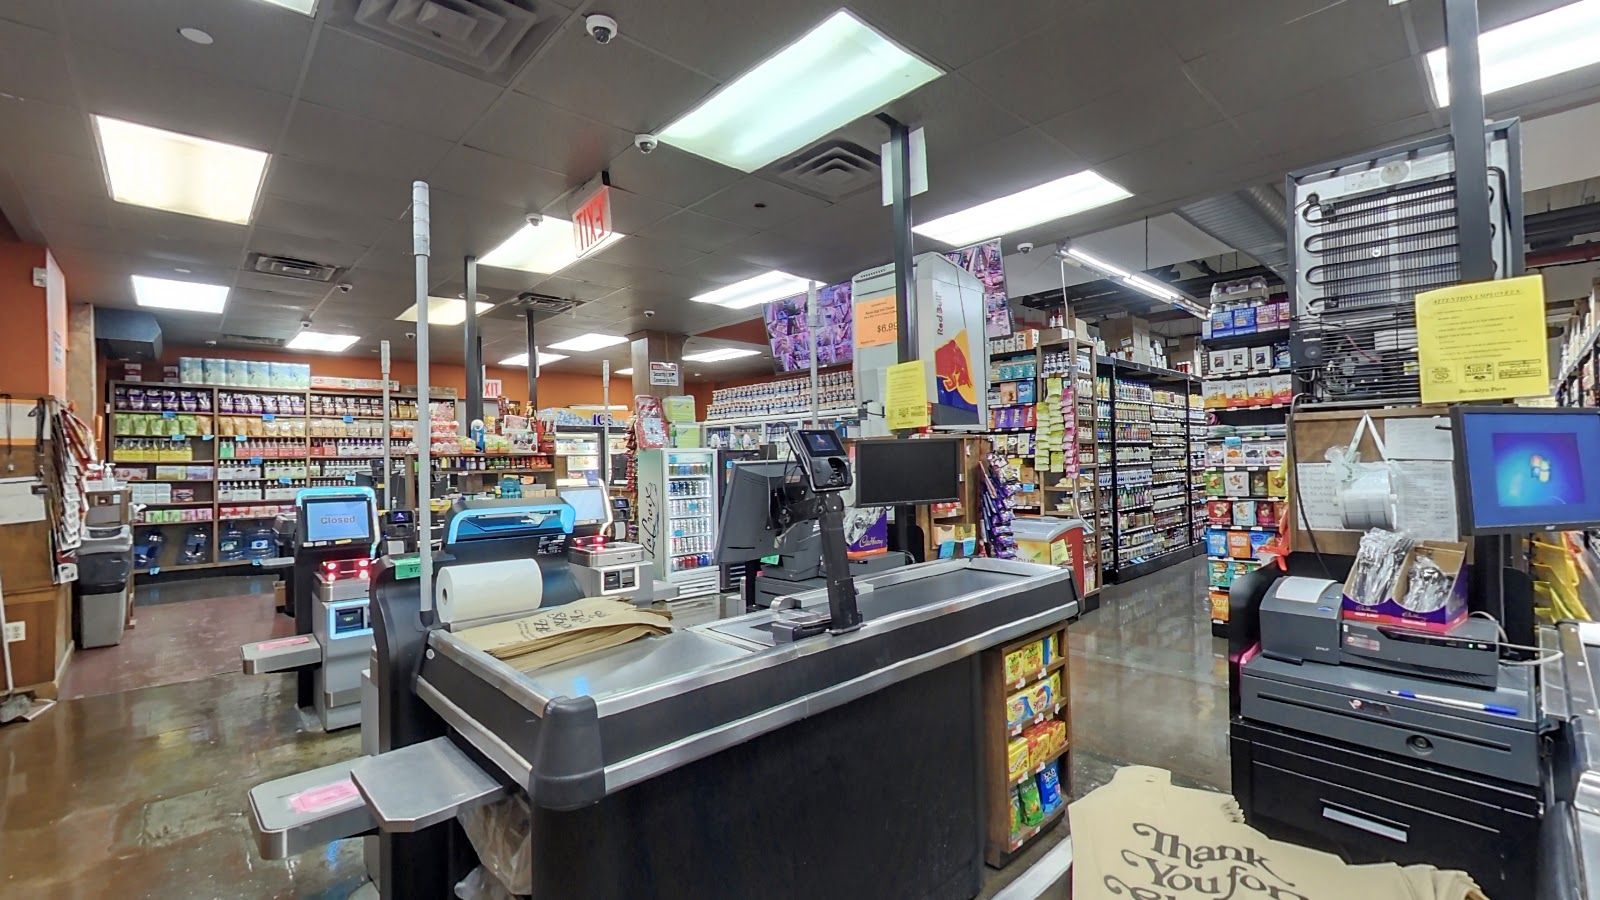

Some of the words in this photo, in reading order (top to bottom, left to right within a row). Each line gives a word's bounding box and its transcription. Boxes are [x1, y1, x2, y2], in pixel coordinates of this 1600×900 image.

[1434, 295, 1473, 305] ATTENTION
[936, 314, 944, 336] Red
[485, 383, 498, 397] XIT
[320, 515, 356, 525] Closed
[1133, 822, 1296, 887] Thank
[1121, 849, 1220, 894] You
[1216, 865, 1309, 900] for
